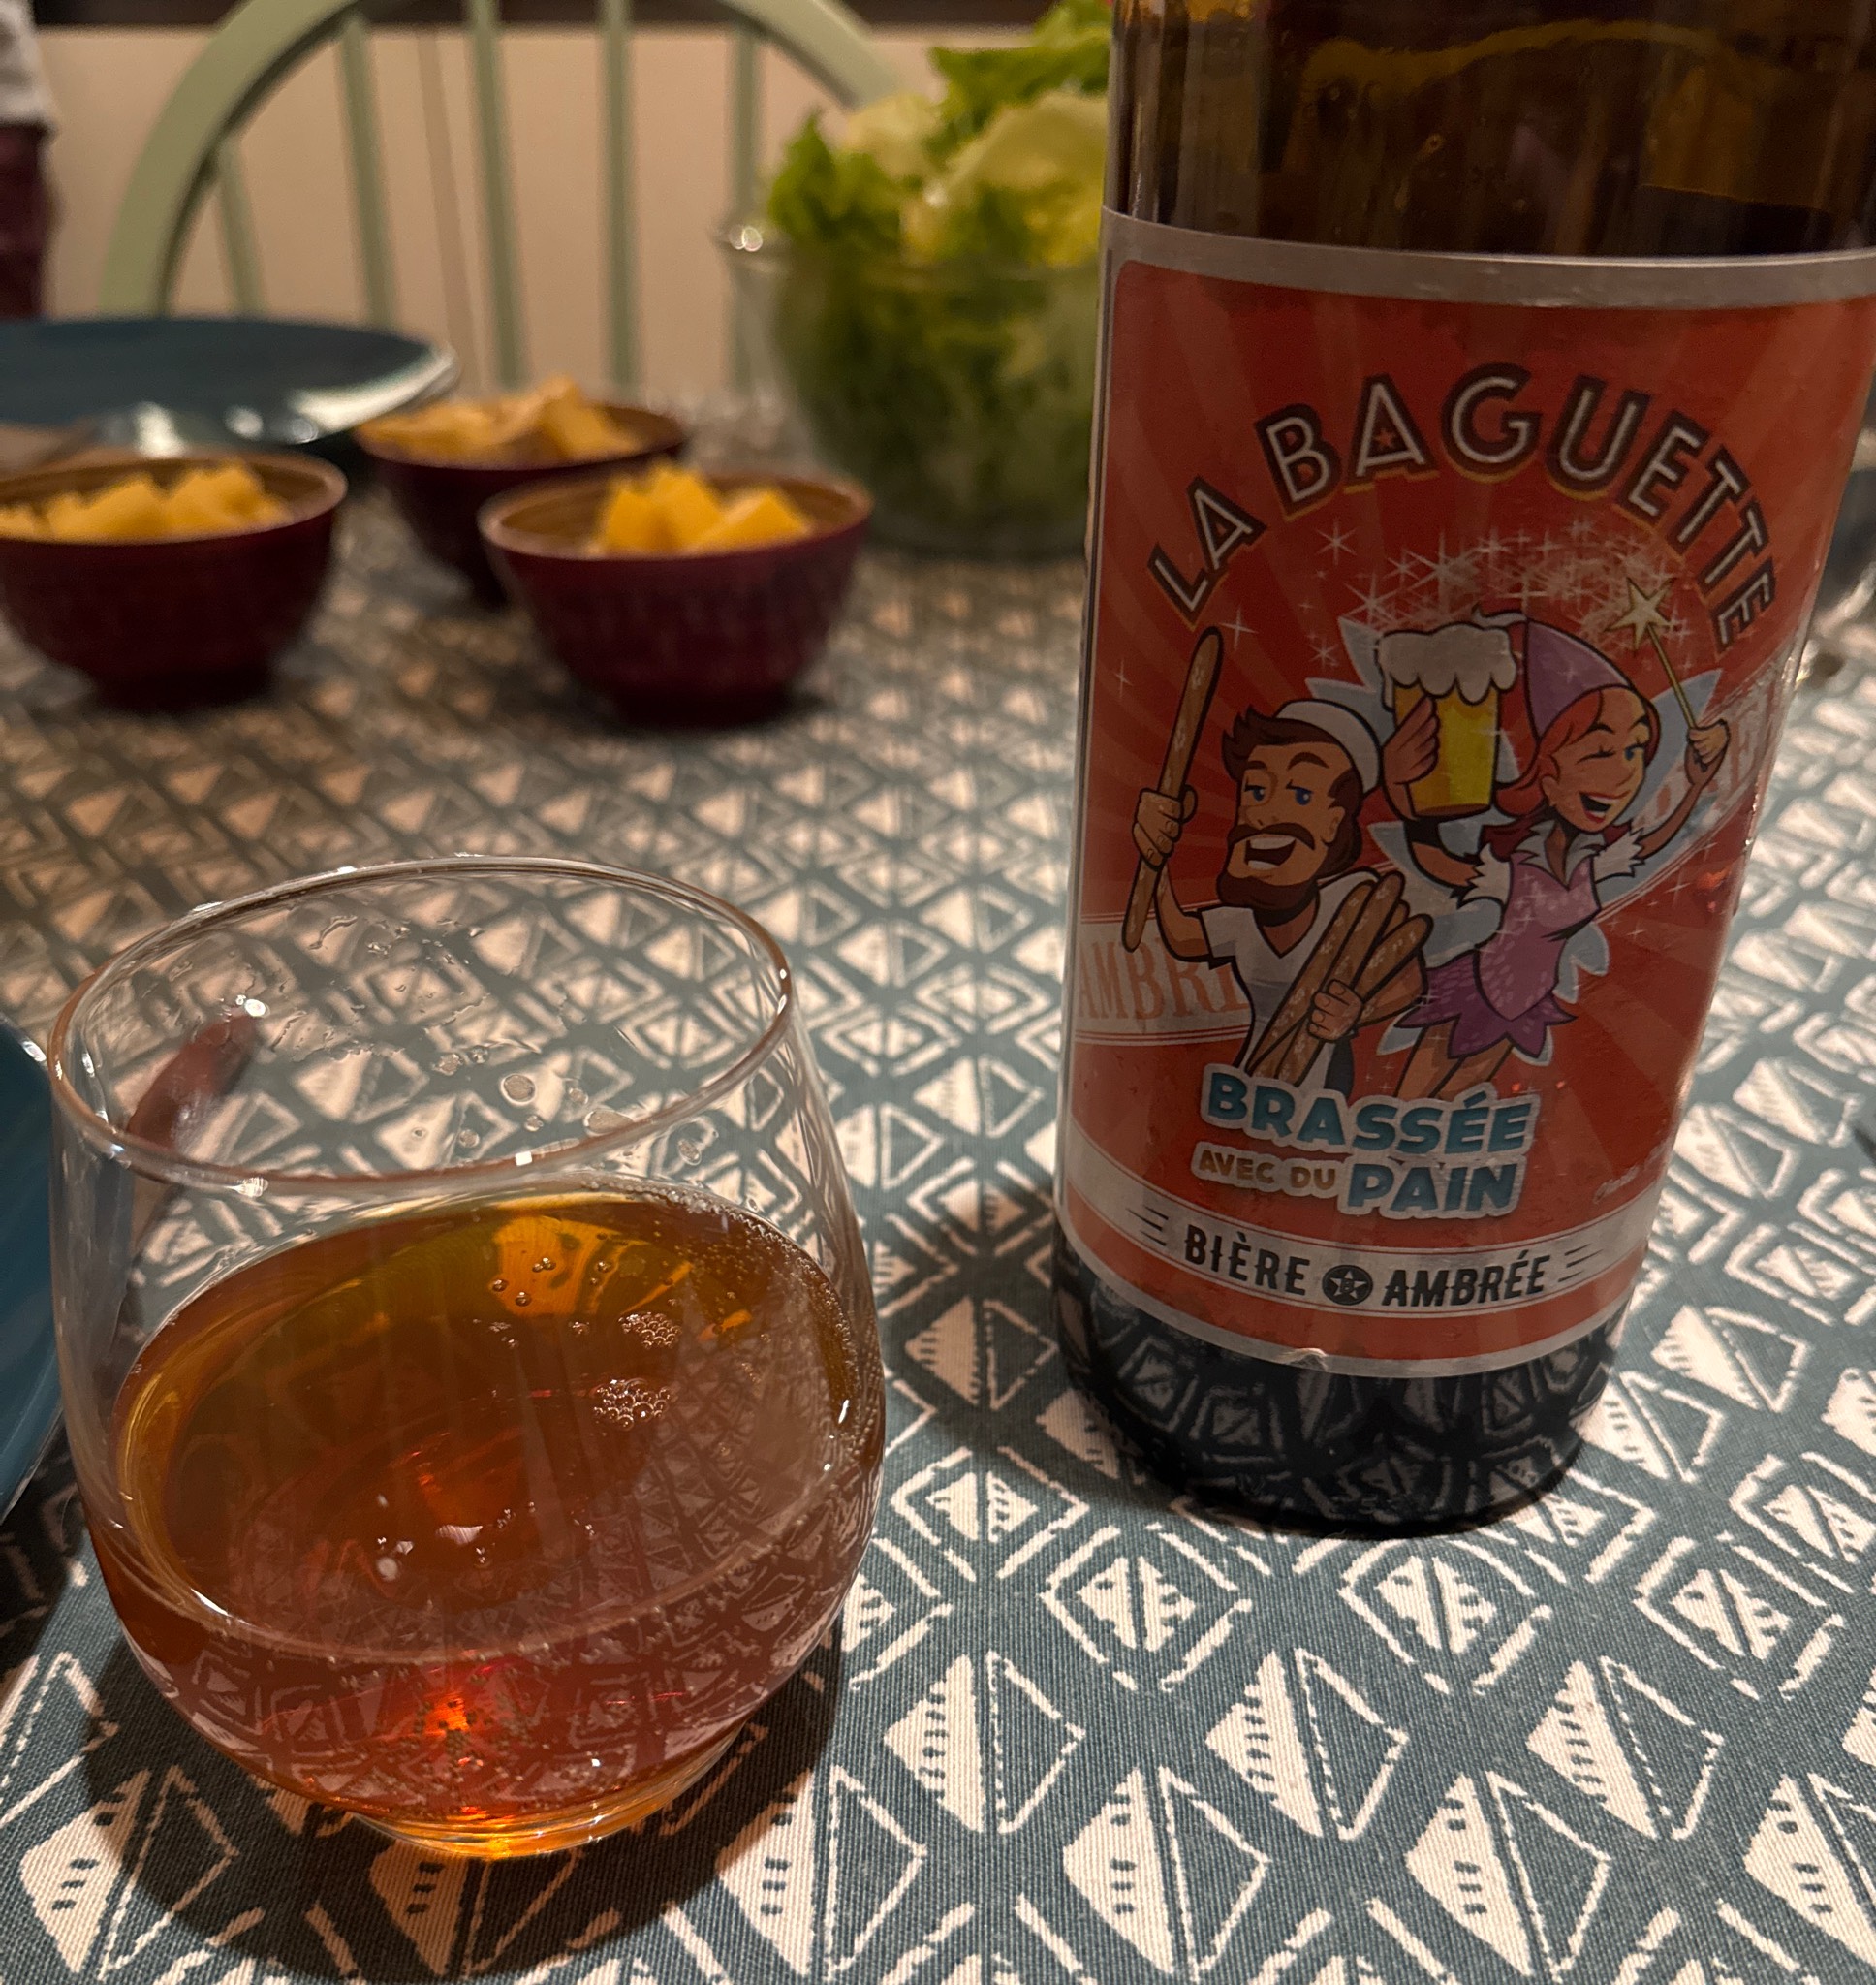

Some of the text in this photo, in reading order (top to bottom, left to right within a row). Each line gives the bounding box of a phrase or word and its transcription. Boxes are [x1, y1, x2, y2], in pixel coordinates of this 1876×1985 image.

[1150, 363, 1777, 653] LA BAGUETTE
[1209, 1071, 1533, 1155] BRASSÉE
[1198, 1149, 1518, 1212] AVEC DU PAIN
[1184, 1223, 1310, 1296] BIÈRE
[1381, 1250, 1551, 1307] AMBRÉE
